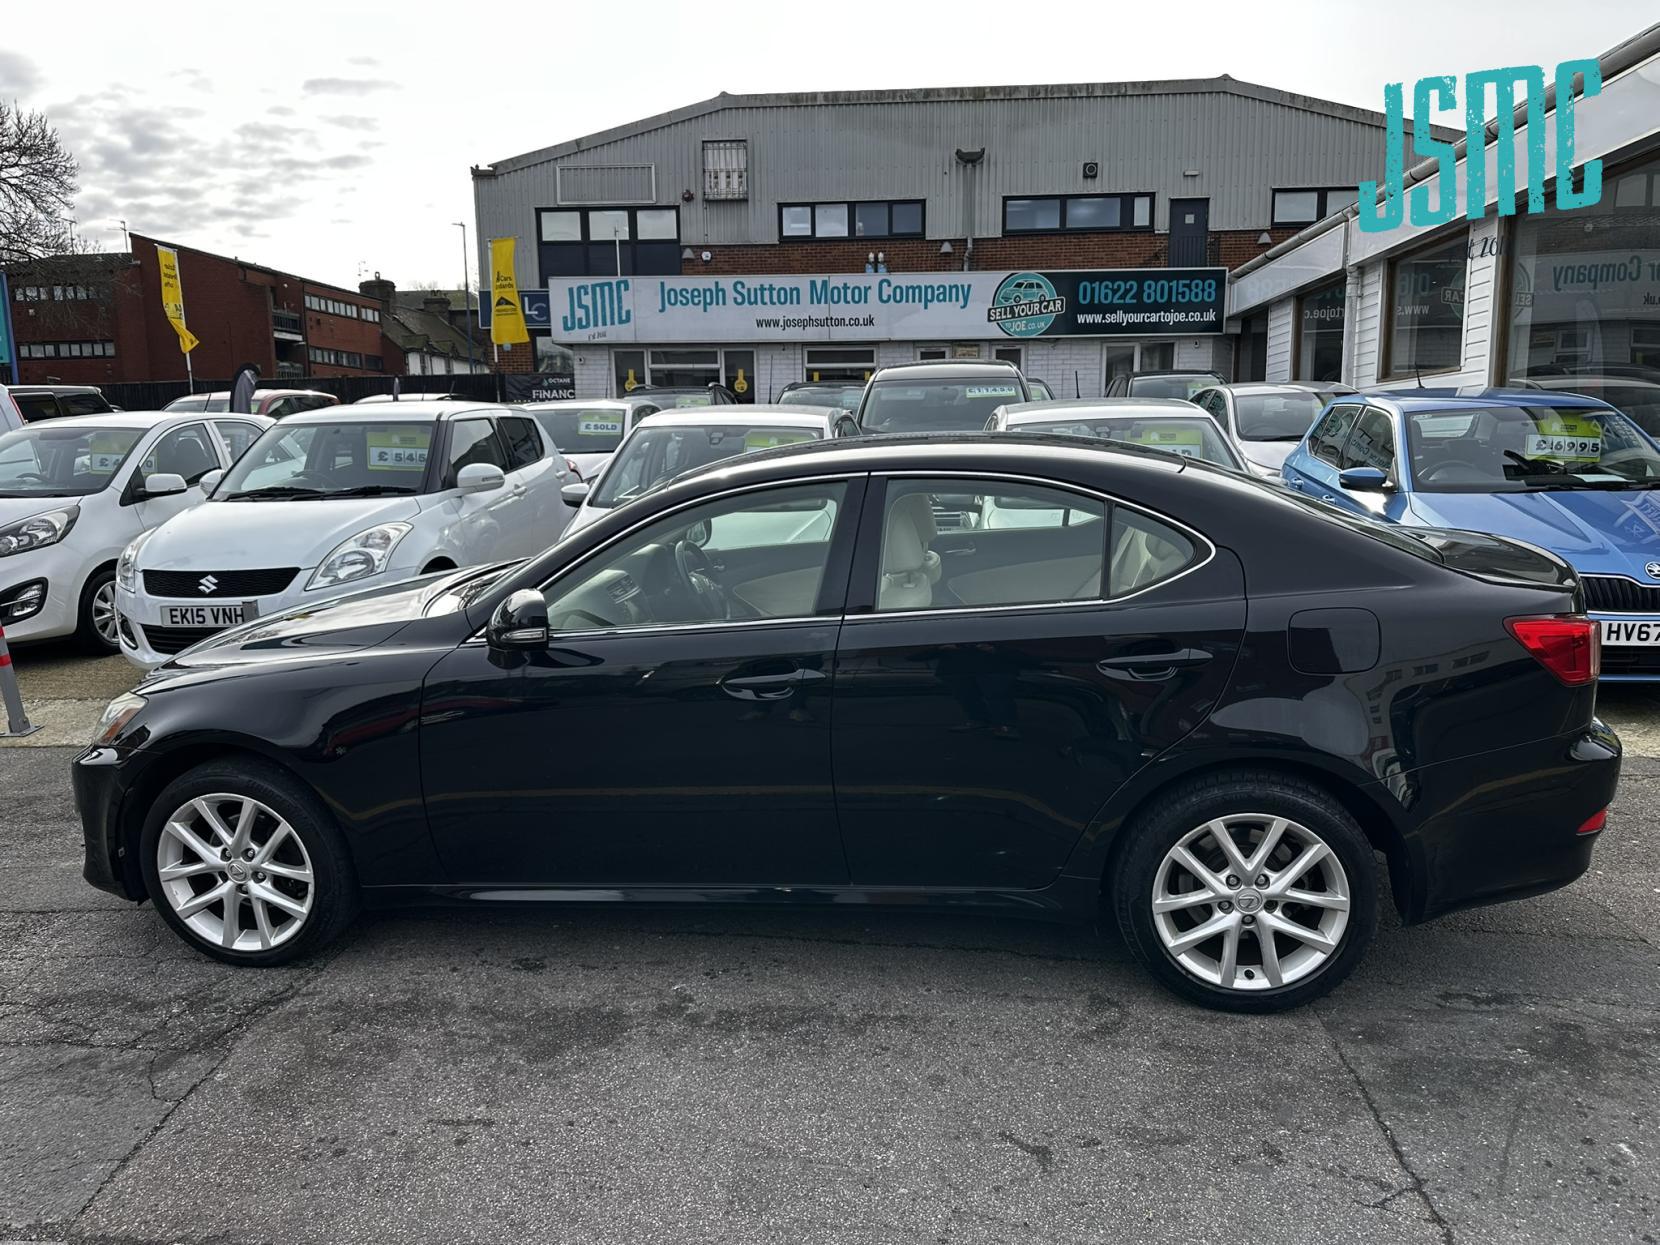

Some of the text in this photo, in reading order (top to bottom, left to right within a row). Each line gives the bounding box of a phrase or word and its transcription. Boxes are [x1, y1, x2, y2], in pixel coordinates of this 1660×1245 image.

[658, 278, 972, 313] Joseph Sutton Motor Company
[1078, 279, 1216, 305] 01622 801588
[562, 279, 631, 332] JSMC
[989, 299, 1062, 321] SELL YOUR CAR
[756, 314, 875, 331] www.josephsutton.co.uk
[1010, 321, 1027, 332] JOE
[1077, 308, 1217, 326] www.sellyourcartojoe.co.uk
[593, 423, 618, 431] SOLD
[169, 607, 245, 625] EK15 VNH
[1606, 622, 1660, 642] HV67
